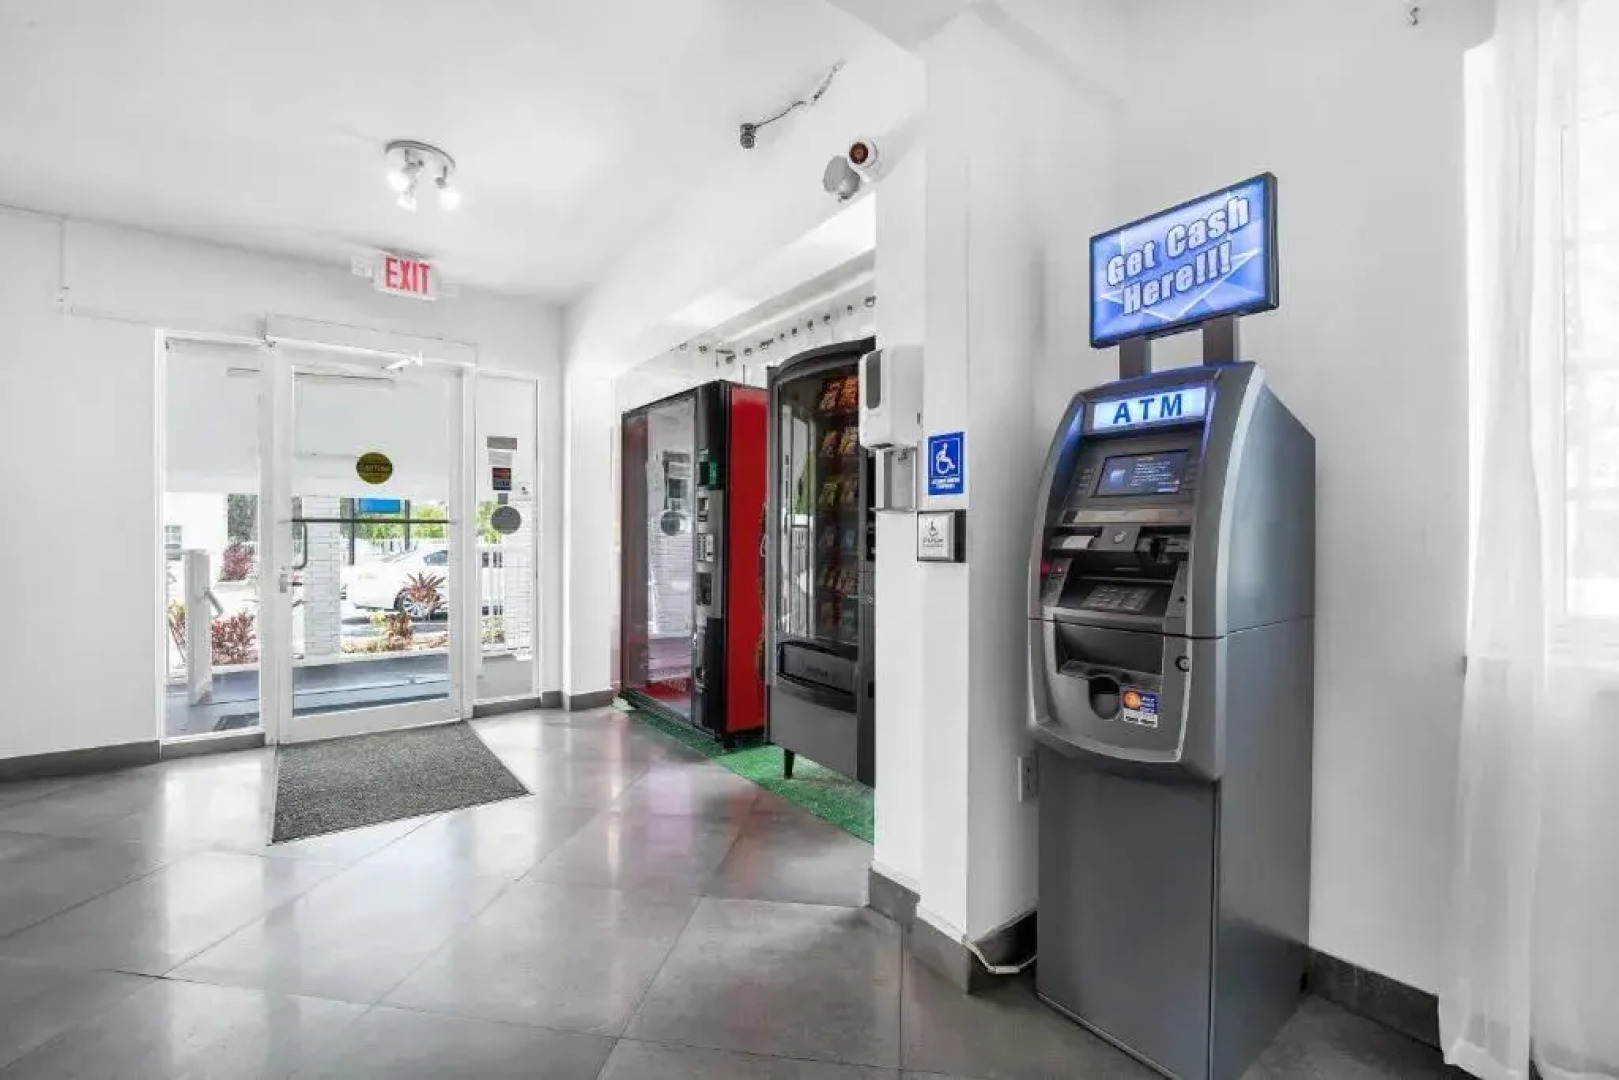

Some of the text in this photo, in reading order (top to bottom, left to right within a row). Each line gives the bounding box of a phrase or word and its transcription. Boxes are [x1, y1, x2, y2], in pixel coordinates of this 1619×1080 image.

[1106, 196, 1250, 287] Get Cash
[385, 257, 430, 294] EXIT
[1122, 240, 1231, 316] Here!!!
[1113, 393, 1183, 425] ATM
